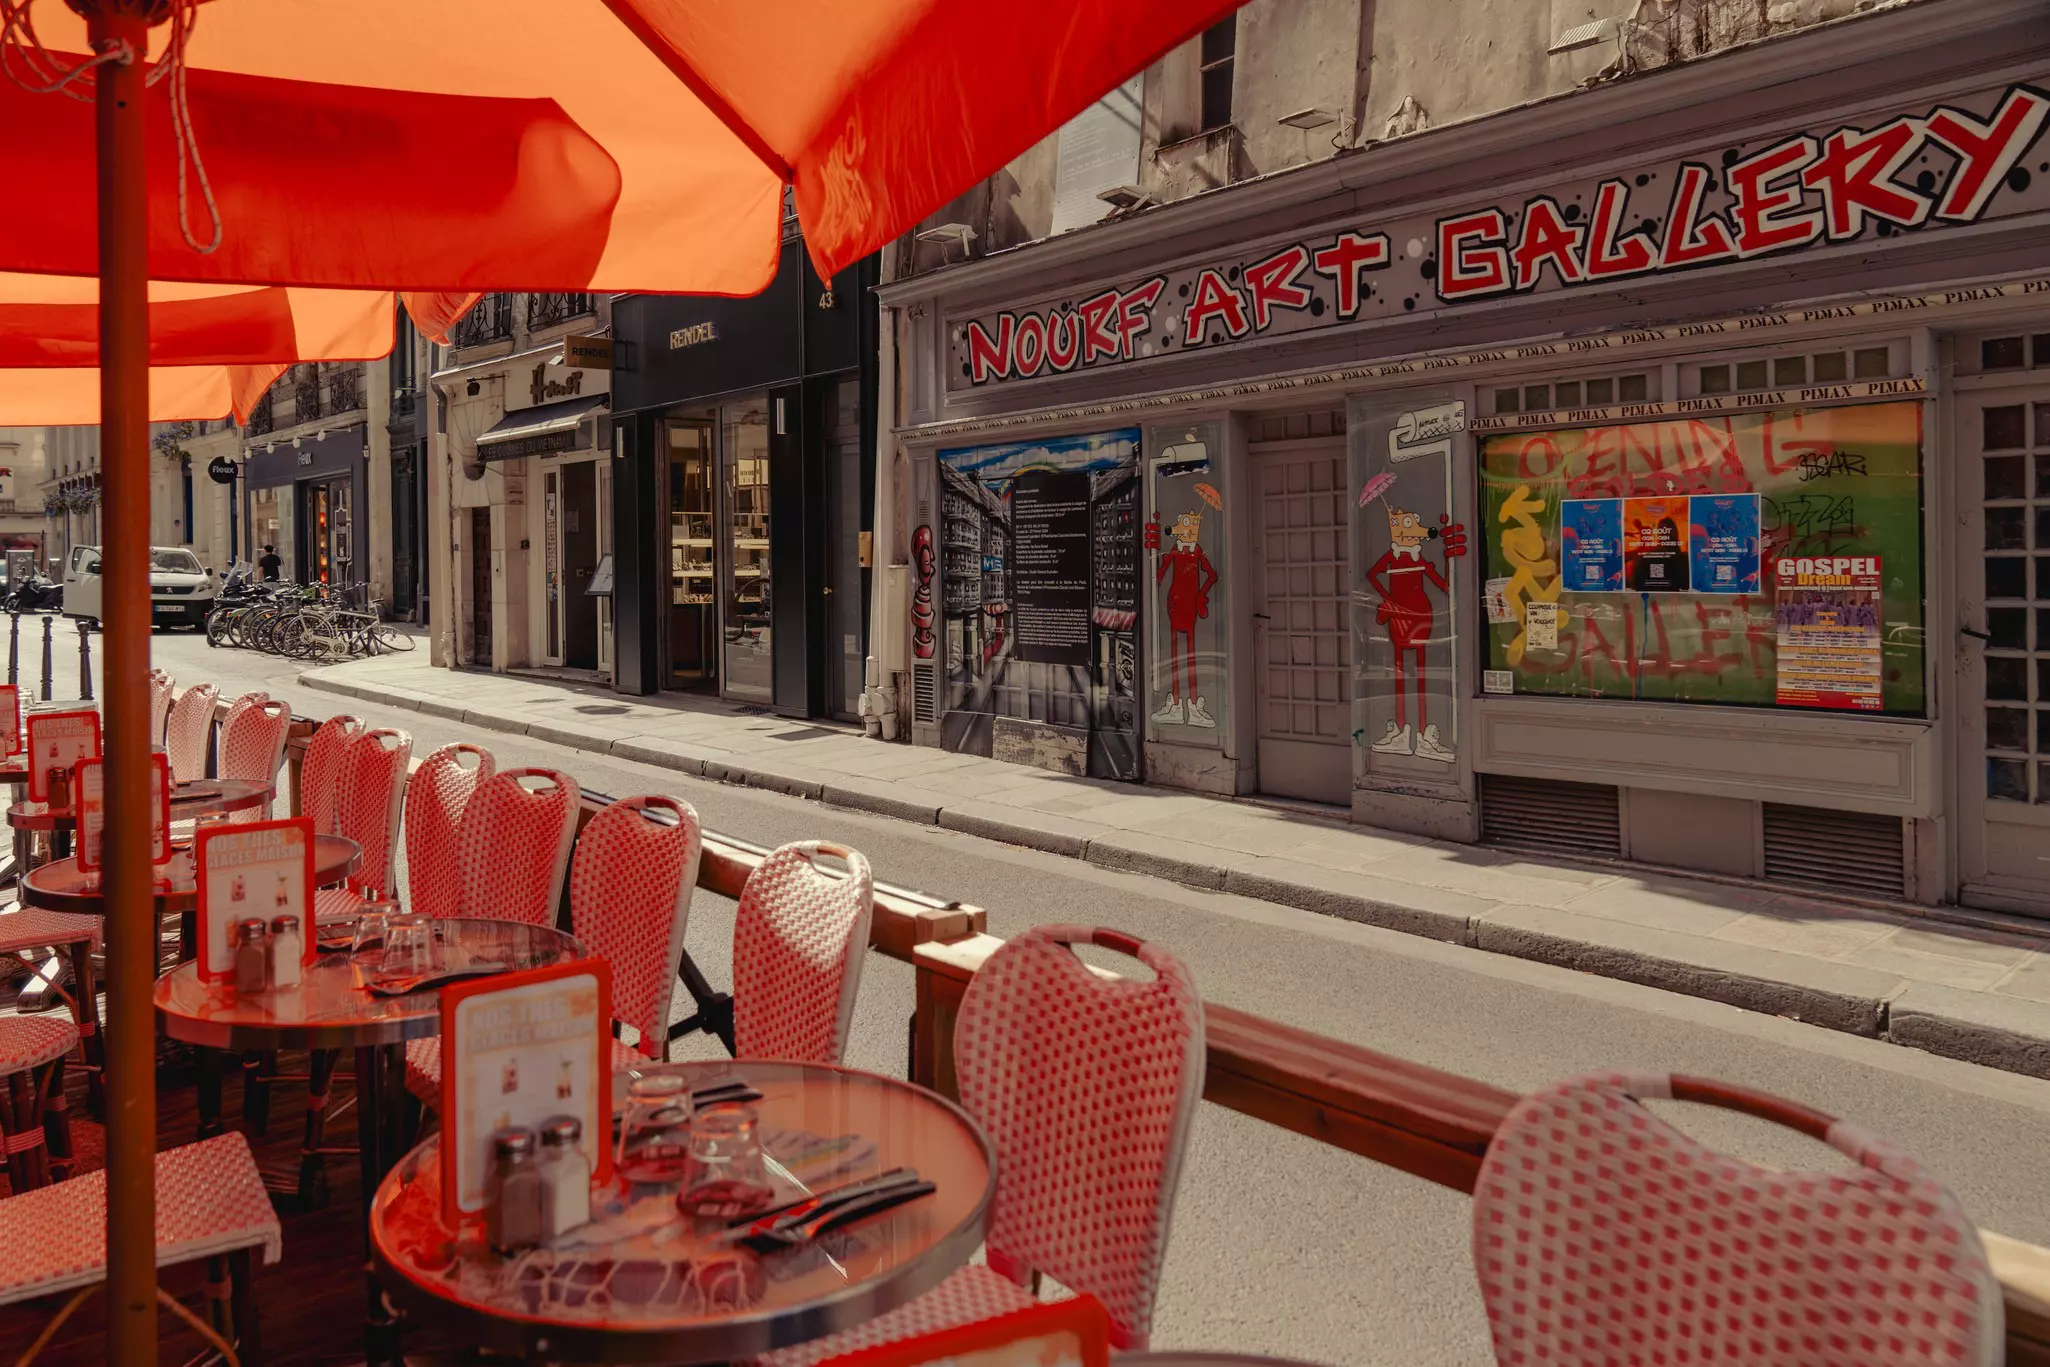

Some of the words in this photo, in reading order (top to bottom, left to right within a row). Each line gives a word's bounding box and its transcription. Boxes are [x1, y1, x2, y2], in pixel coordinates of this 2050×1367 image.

[964, 275, 1167, 386] NOURF
[1182, 230, 1391, 348] ART
[1436, 82, 2050, 304] GALLERY
[669, 321, 717, 350] RENDEL
[1267, 380, 1296, 391] PIMAX
[1303, 375, 1333, 386] PIMAX
[1341, 369, 1374, 380] PIMAX
[1380, 363, 1414, 376] PIMAX
[1423, 358, 1458, 370] PIMAX
[1469, 352, 1507, 364] PIMAX
[1517, 345, 1557, 357] PIMAX
[1568, 338, 1610, 352] PIMAX
[1622, 331, 1665, 345] PIMAX
[1679, 322, 1726, 337] PIMAX
[1740, 314, 1789, 329] PIMAX
[1803, 306, 1856, 321] PIMAX
[1871, 296, 1928, 314] PIMAX
[1945, 287, 2004, 304] PIMAX
[572, 346, 609, 359] RENDEL
[1469, 419, 1507, 430] PIMAX
[1518, 413, 1557, 425] PIMAX
[1568, 409, 1609, 421] PIMAX
[1621, 403, 1665, 417] PIMAX
[1677, 397, 1724, 412] PIMAX
[1737, 391, 1786, 406] PIMAX
[1800, 385, 1853, 401] PIMAX
[1868, 378, 1923, 395] PIMAX
[1777, 558, 1880, 576] GOSPEL
[1797, 574, 1852, 586] Dream
[1518, 598, 1777, 682] GALLER
[207, 850, 253, 868] GLACES
[256, 843, 305, 861] MAISON
